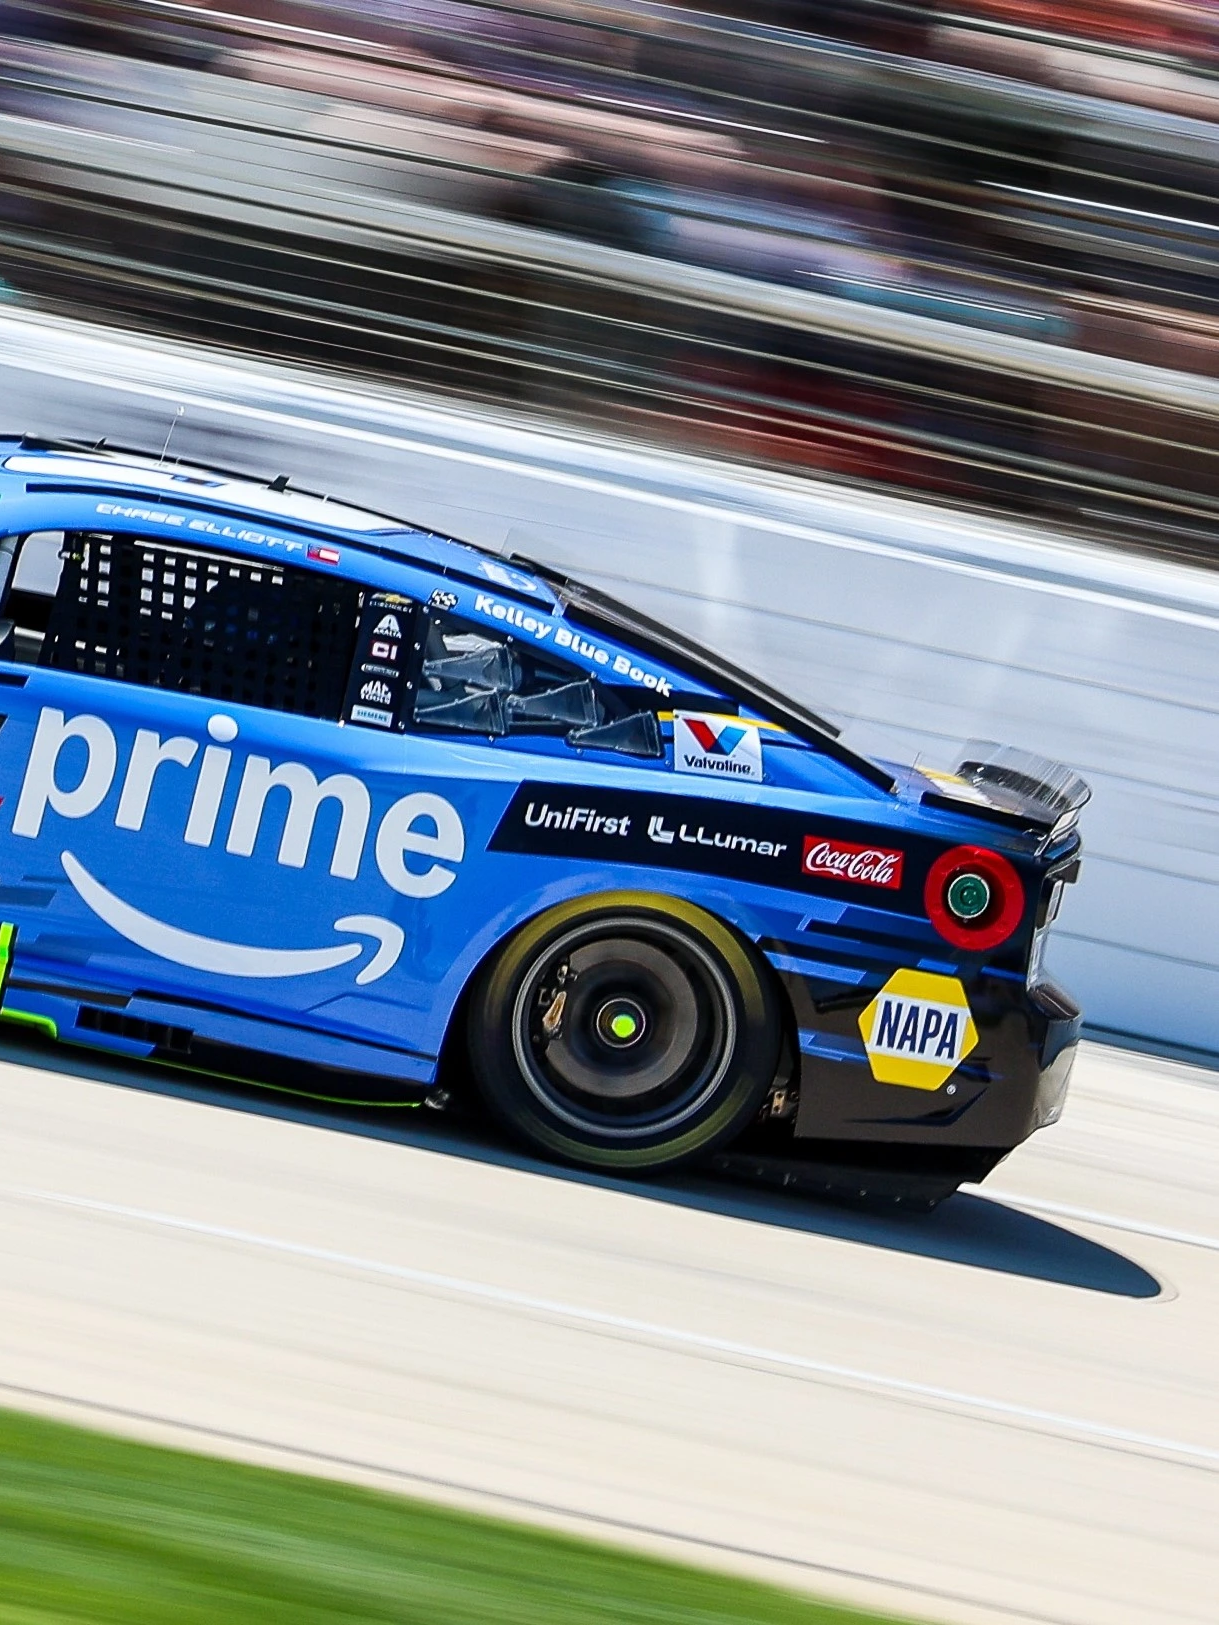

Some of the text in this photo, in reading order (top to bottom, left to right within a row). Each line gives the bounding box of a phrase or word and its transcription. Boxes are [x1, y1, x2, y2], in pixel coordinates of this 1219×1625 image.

[95, 503, 304, 553] CHASE ELLIOTT
[474, 594, 674, 698] Kelley Blue Book
[683, 754, 752, 776] Valvoline
[11, 704, 466, 900] prime
[523, 802, 632, 837] UniFirst
[804, 841, 901, 885] Coca-Cola
[875, 999, 960, 1060] NAPA
